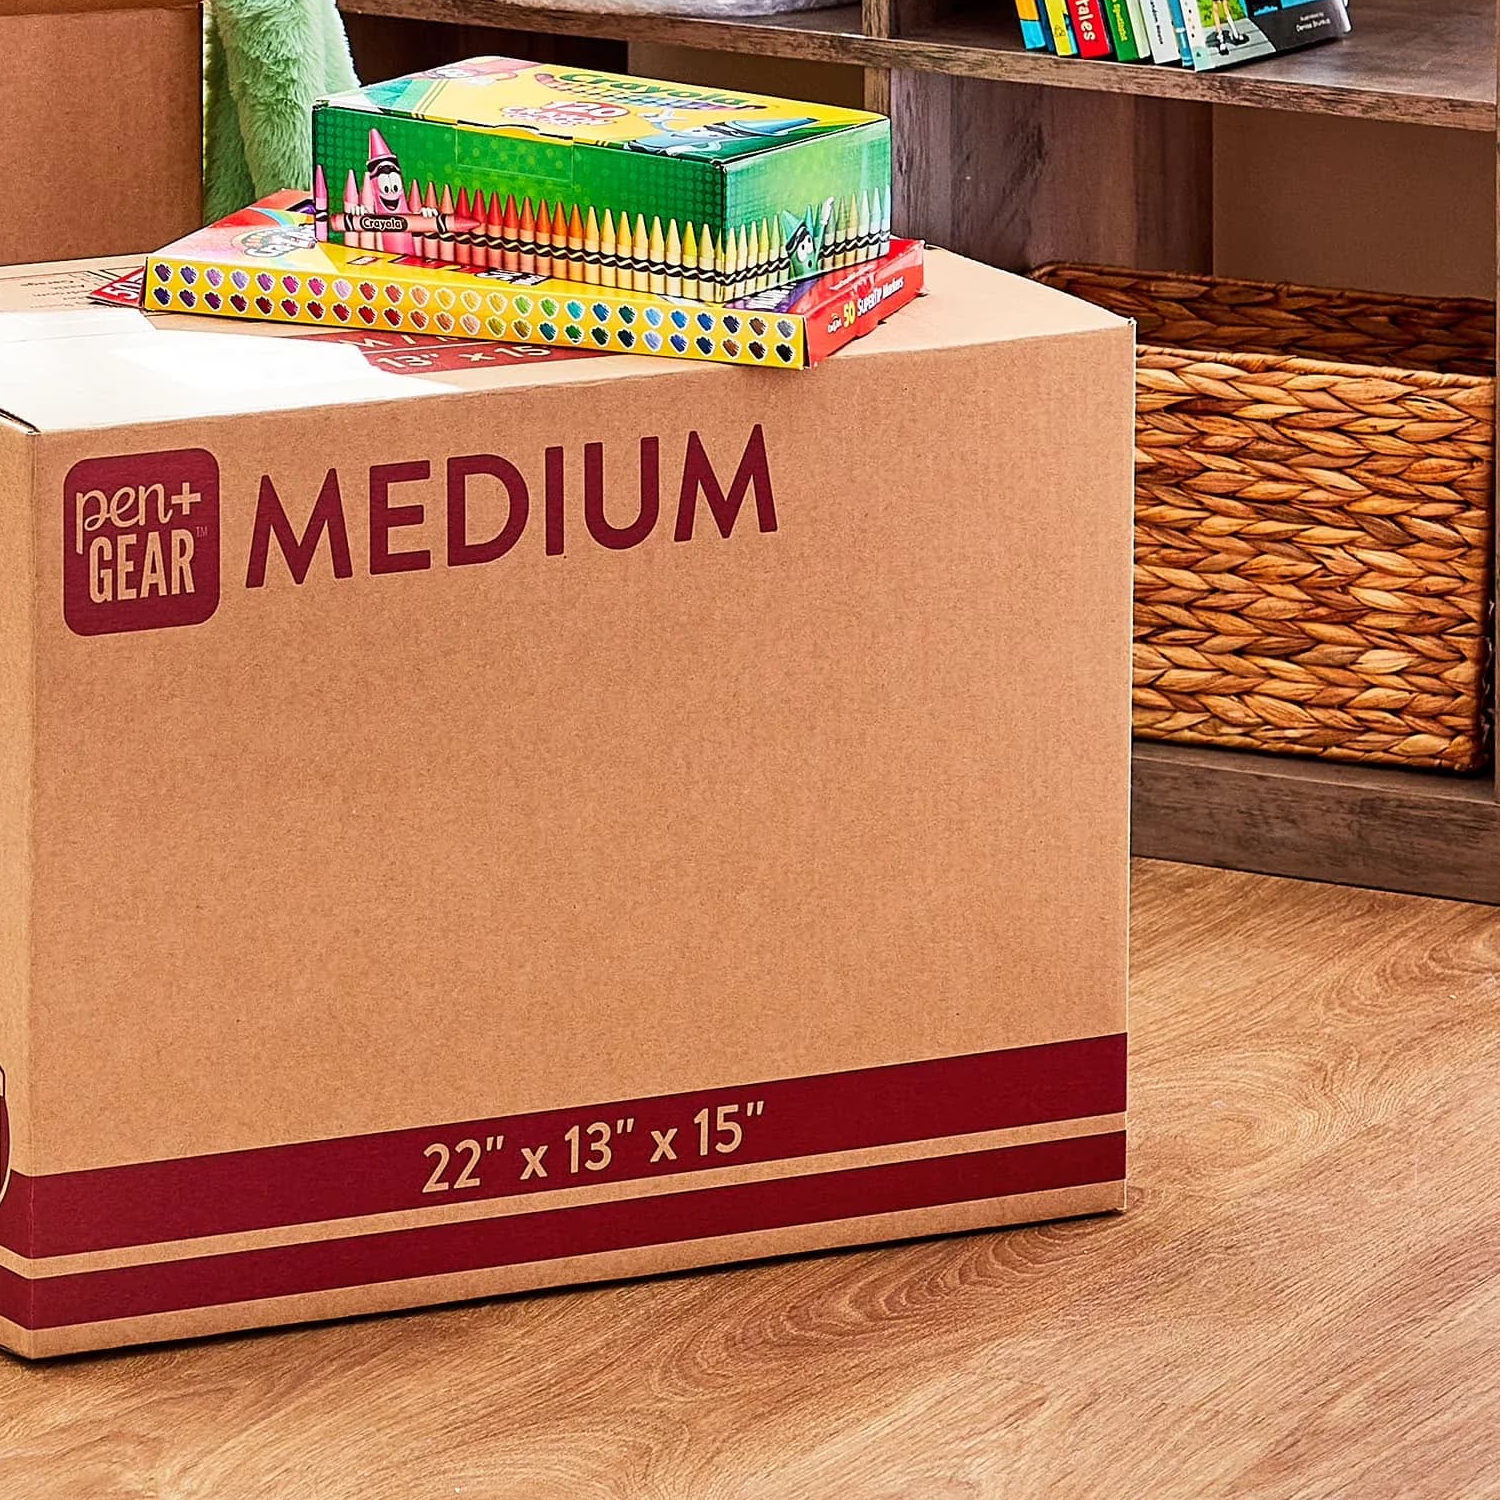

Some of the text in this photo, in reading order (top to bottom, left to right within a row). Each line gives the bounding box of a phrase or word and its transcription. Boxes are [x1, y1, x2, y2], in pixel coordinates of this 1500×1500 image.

[558, 71, 750, 106] Crayola
[363, 218, 404, 230] Crayola
[843, 300, 856, 328] 50
[245, 423, 778, 589] MEDIUM
[89, 528, 196, 604] GEAR
[422, 1100, 764, 1193] 22" x 13" x 15"
